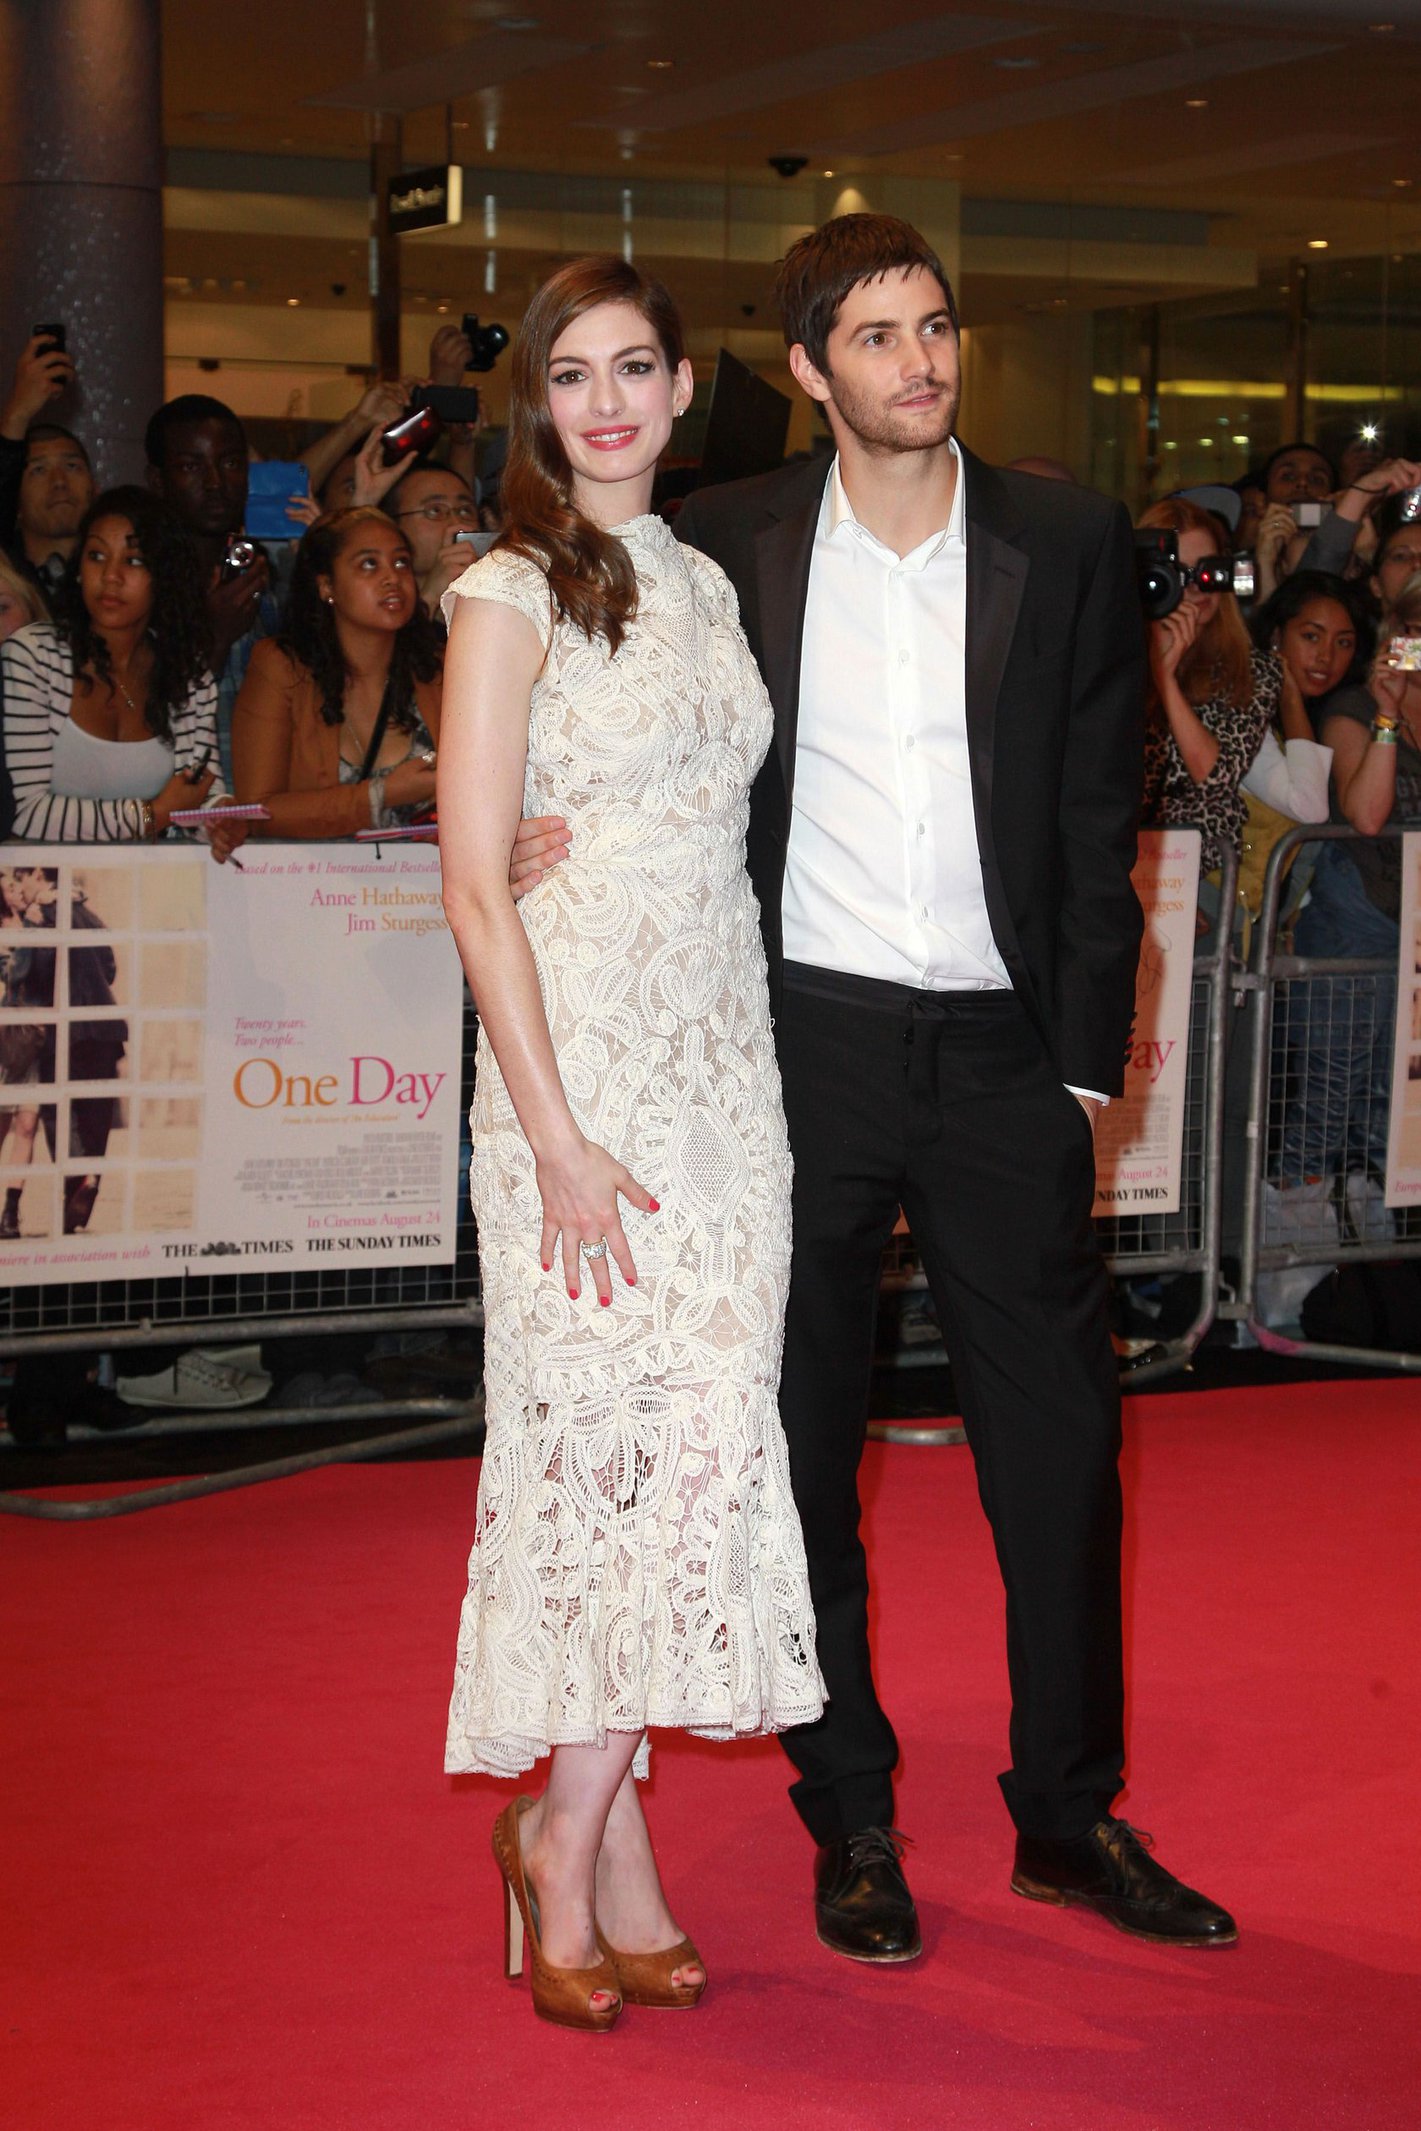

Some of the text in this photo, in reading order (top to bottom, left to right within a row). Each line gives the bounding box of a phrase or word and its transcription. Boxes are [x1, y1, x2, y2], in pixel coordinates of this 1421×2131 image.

[270, 864, 284, 874] on
[288, 862, 303, 874] the
[326, 861, 396, 874] International
[310, 888, 356, 906] Anne
[346, 912, 451, 936] Jim Sturgess
[234, 1017, 273, 1031] Twenty
[234, 1034, 257, 1046] Two
[1126, 1037, 1176, 1083] ay
[233, 1056, 446, 1119] One Day
[1132, 1186, 1168, 1200] TIMES
[307, 1210, 440, 1229] In Cinemas August 24
[162, 1240, 293, 1258] THE TIMES
[306, 1234, 441, 1252] THE SUNDAY TIMES
[34, 1251, 47, 1265] in
[52, 1250, 117, 1265] association
[122, 1246, 150, 1260] with
